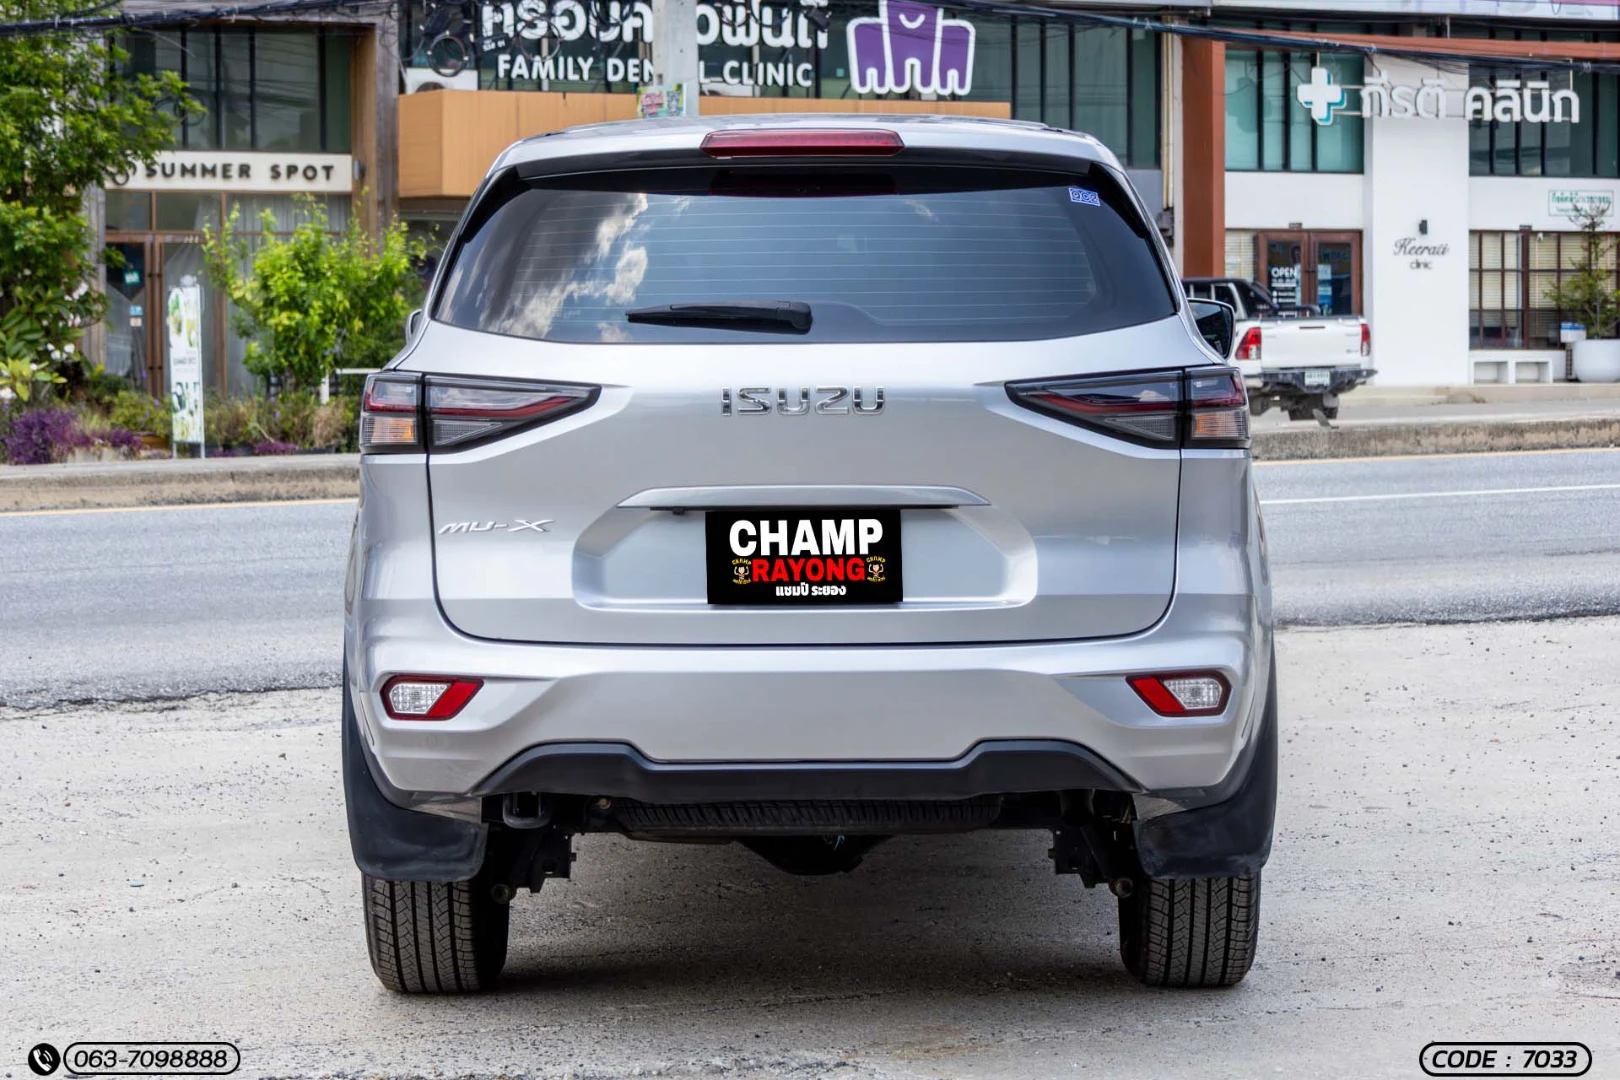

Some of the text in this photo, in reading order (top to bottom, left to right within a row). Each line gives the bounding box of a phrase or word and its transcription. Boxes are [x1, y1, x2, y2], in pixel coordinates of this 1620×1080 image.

[498, 54, 813, 87] FAMILY DENL CLINIC
[1360, 70, 1580, 124] กีรติ คลินิก
[145, 162, 335, 181] SUMMER SPOT
[1271, 267, 1297, 278] OPEN
[721, 385, 885, 416] ISUZU
[438, 519, 556, 534] MU-X
